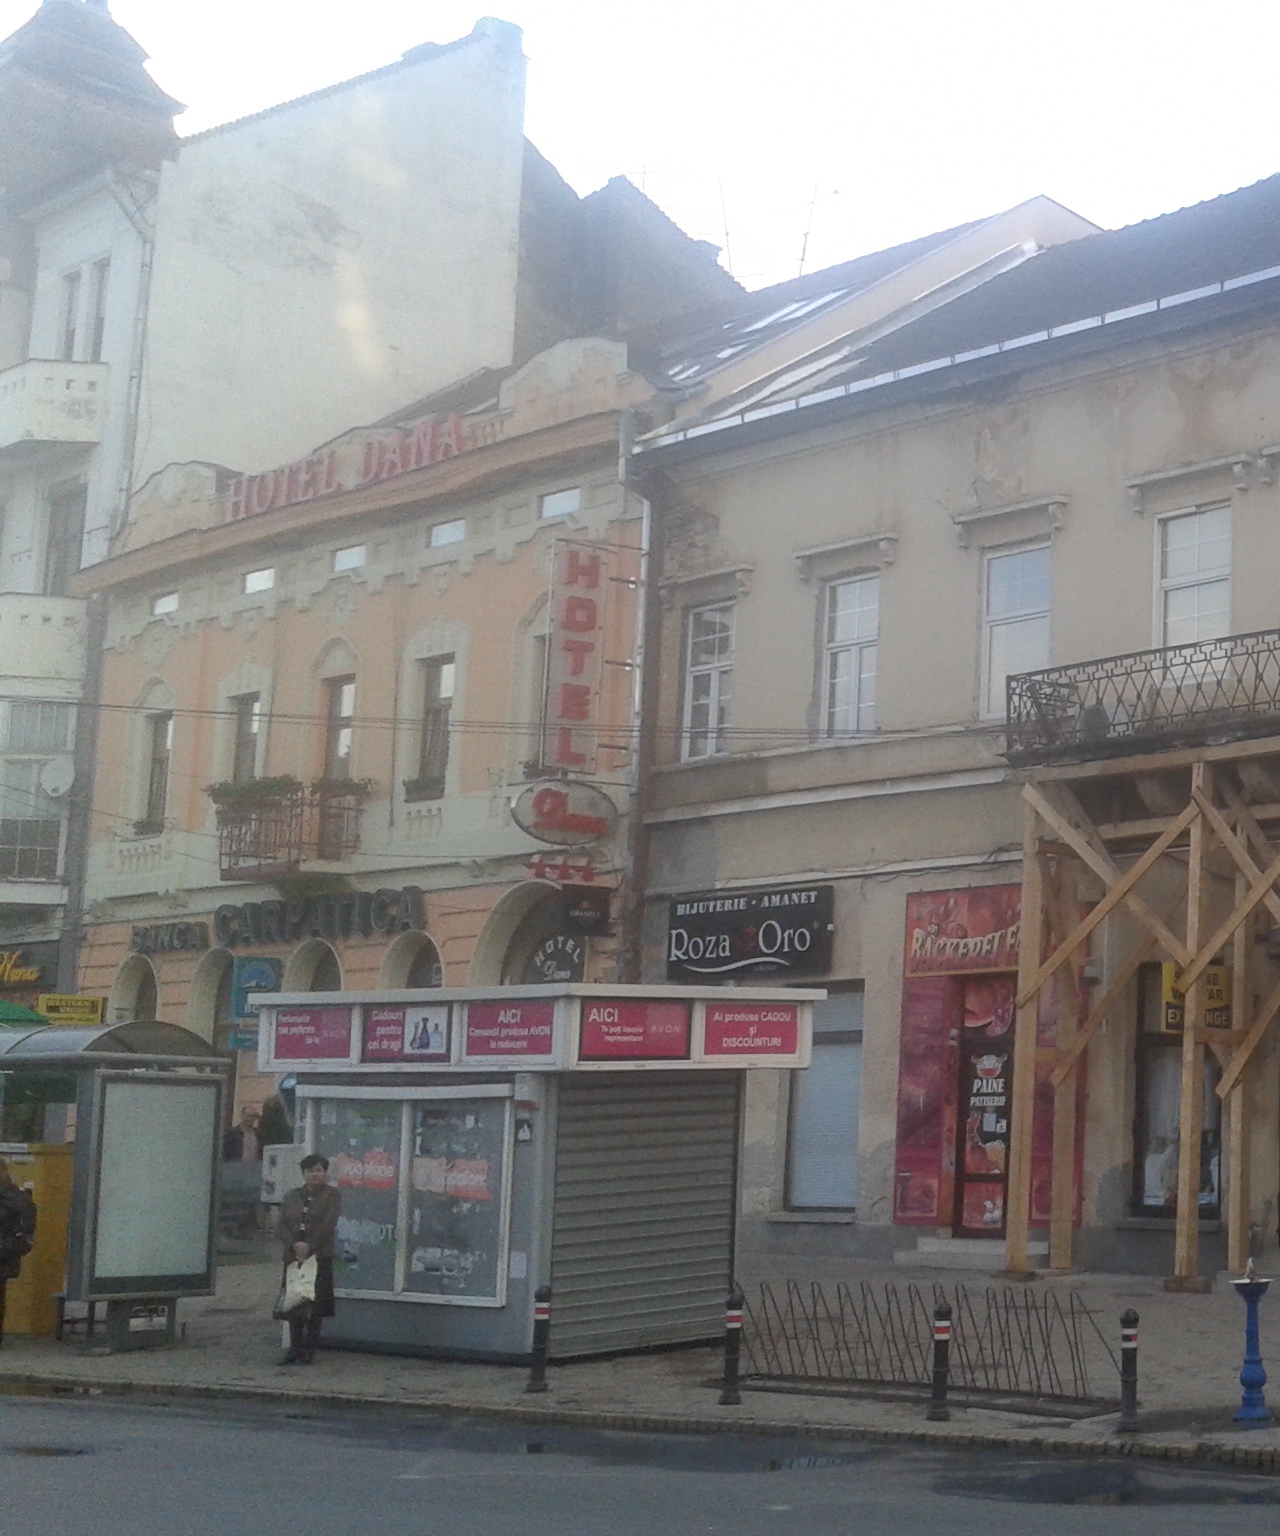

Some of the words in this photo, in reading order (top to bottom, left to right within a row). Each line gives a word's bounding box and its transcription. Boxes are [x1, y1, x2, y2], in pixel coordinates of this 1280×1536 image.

[227, 450, 344, 523] HOTEL
[357, 411, 466, 484] DANA
[555, 549, 600, 764] HOTEL
[676, 897, 747, 915] BIJUTERIE
[761, 891, 817, 907] AMANET
[214, 886, 426, 947] CARPATICA
[669, 928, 731, 961] Roza
[758, 920, 810, 953] Oro
[534, 936, 581, 966] HOTEL
[497, 1009, 521, 1024] AICI
[588, 1007, 618, 1023] AICI
[725, 1012, 759, 1023] produse
[760, 1011, 791, 1022] CADOU
[529, 1025, 551, 1036] AVON
[650, 1024, 681, 1034] AVON
[722, 1037, 781, 1047] DISCOUNTURI
[972, 1078, 1005, 1093] PAINE
